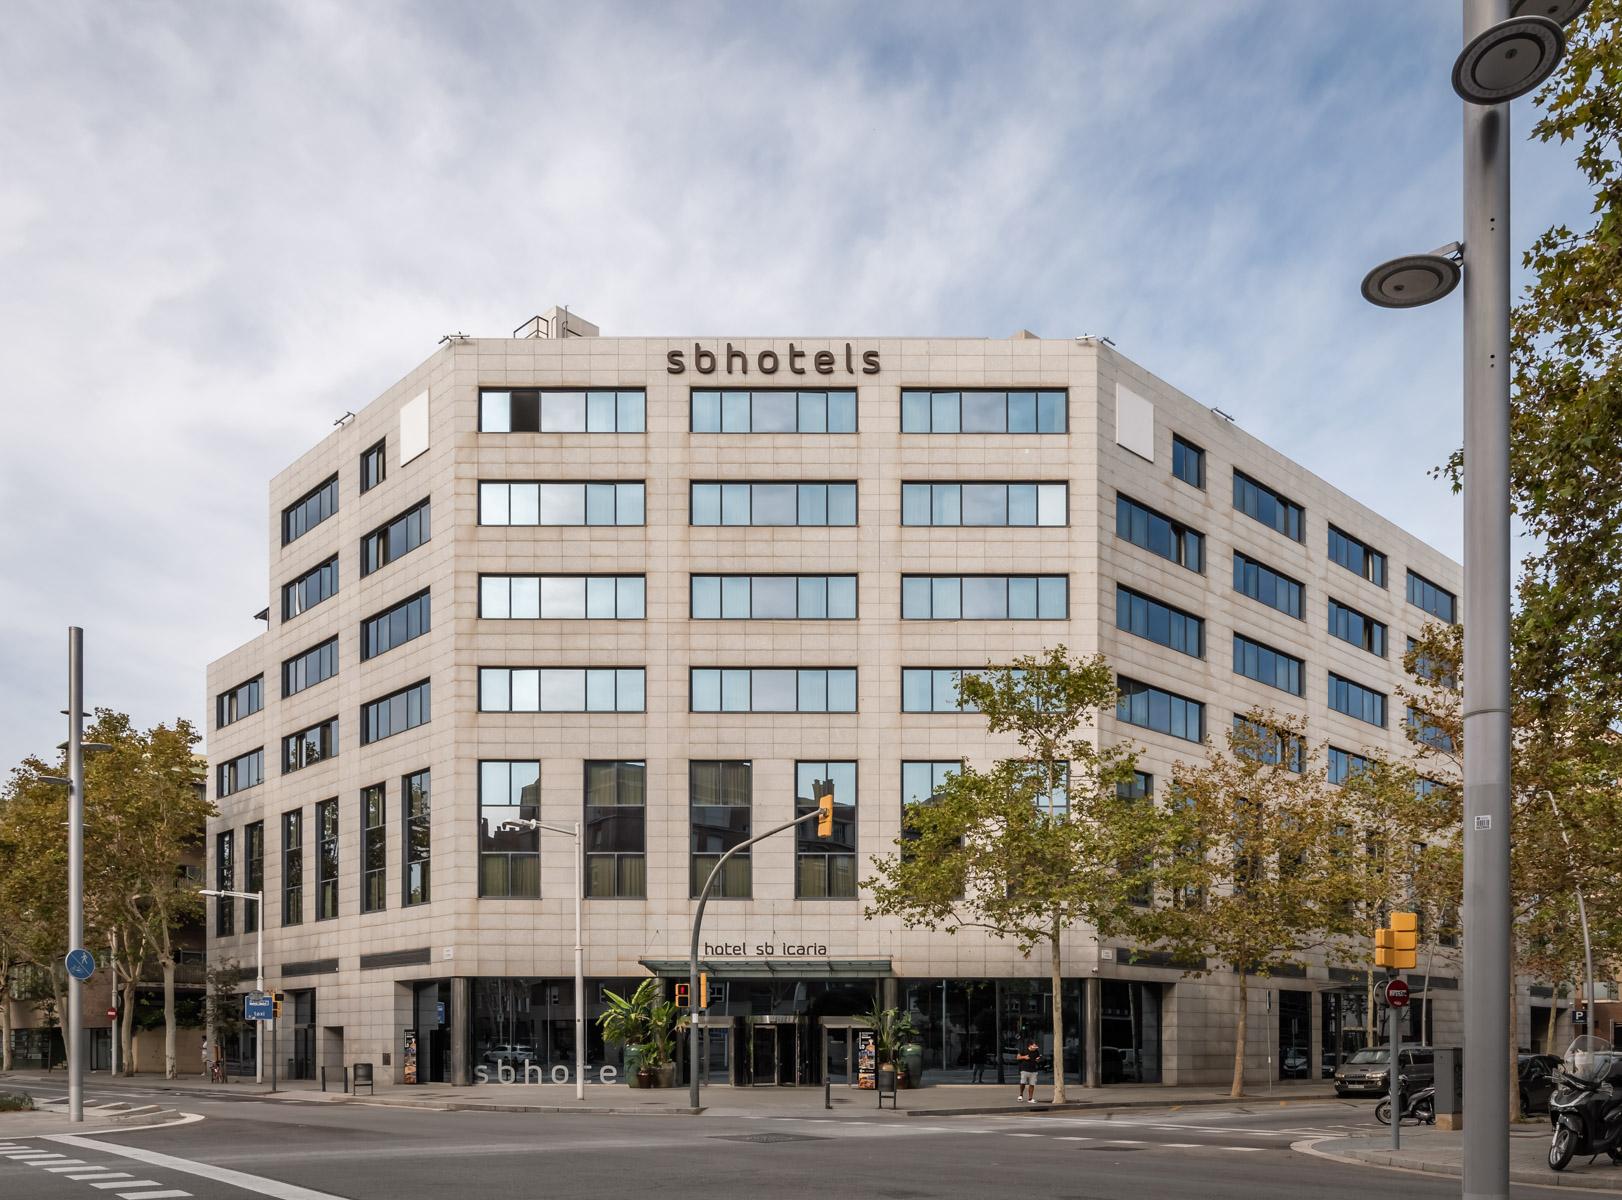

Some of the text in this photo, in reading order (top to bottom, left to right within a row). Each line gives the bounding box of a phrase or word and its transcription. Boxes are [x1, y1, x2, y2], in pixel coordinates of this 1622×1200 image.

[666, 342, 881, 375] sbhotels
[704, 941, 827, 956] hotel sb icaria
[1575, 1011, 1584, 1020] P
